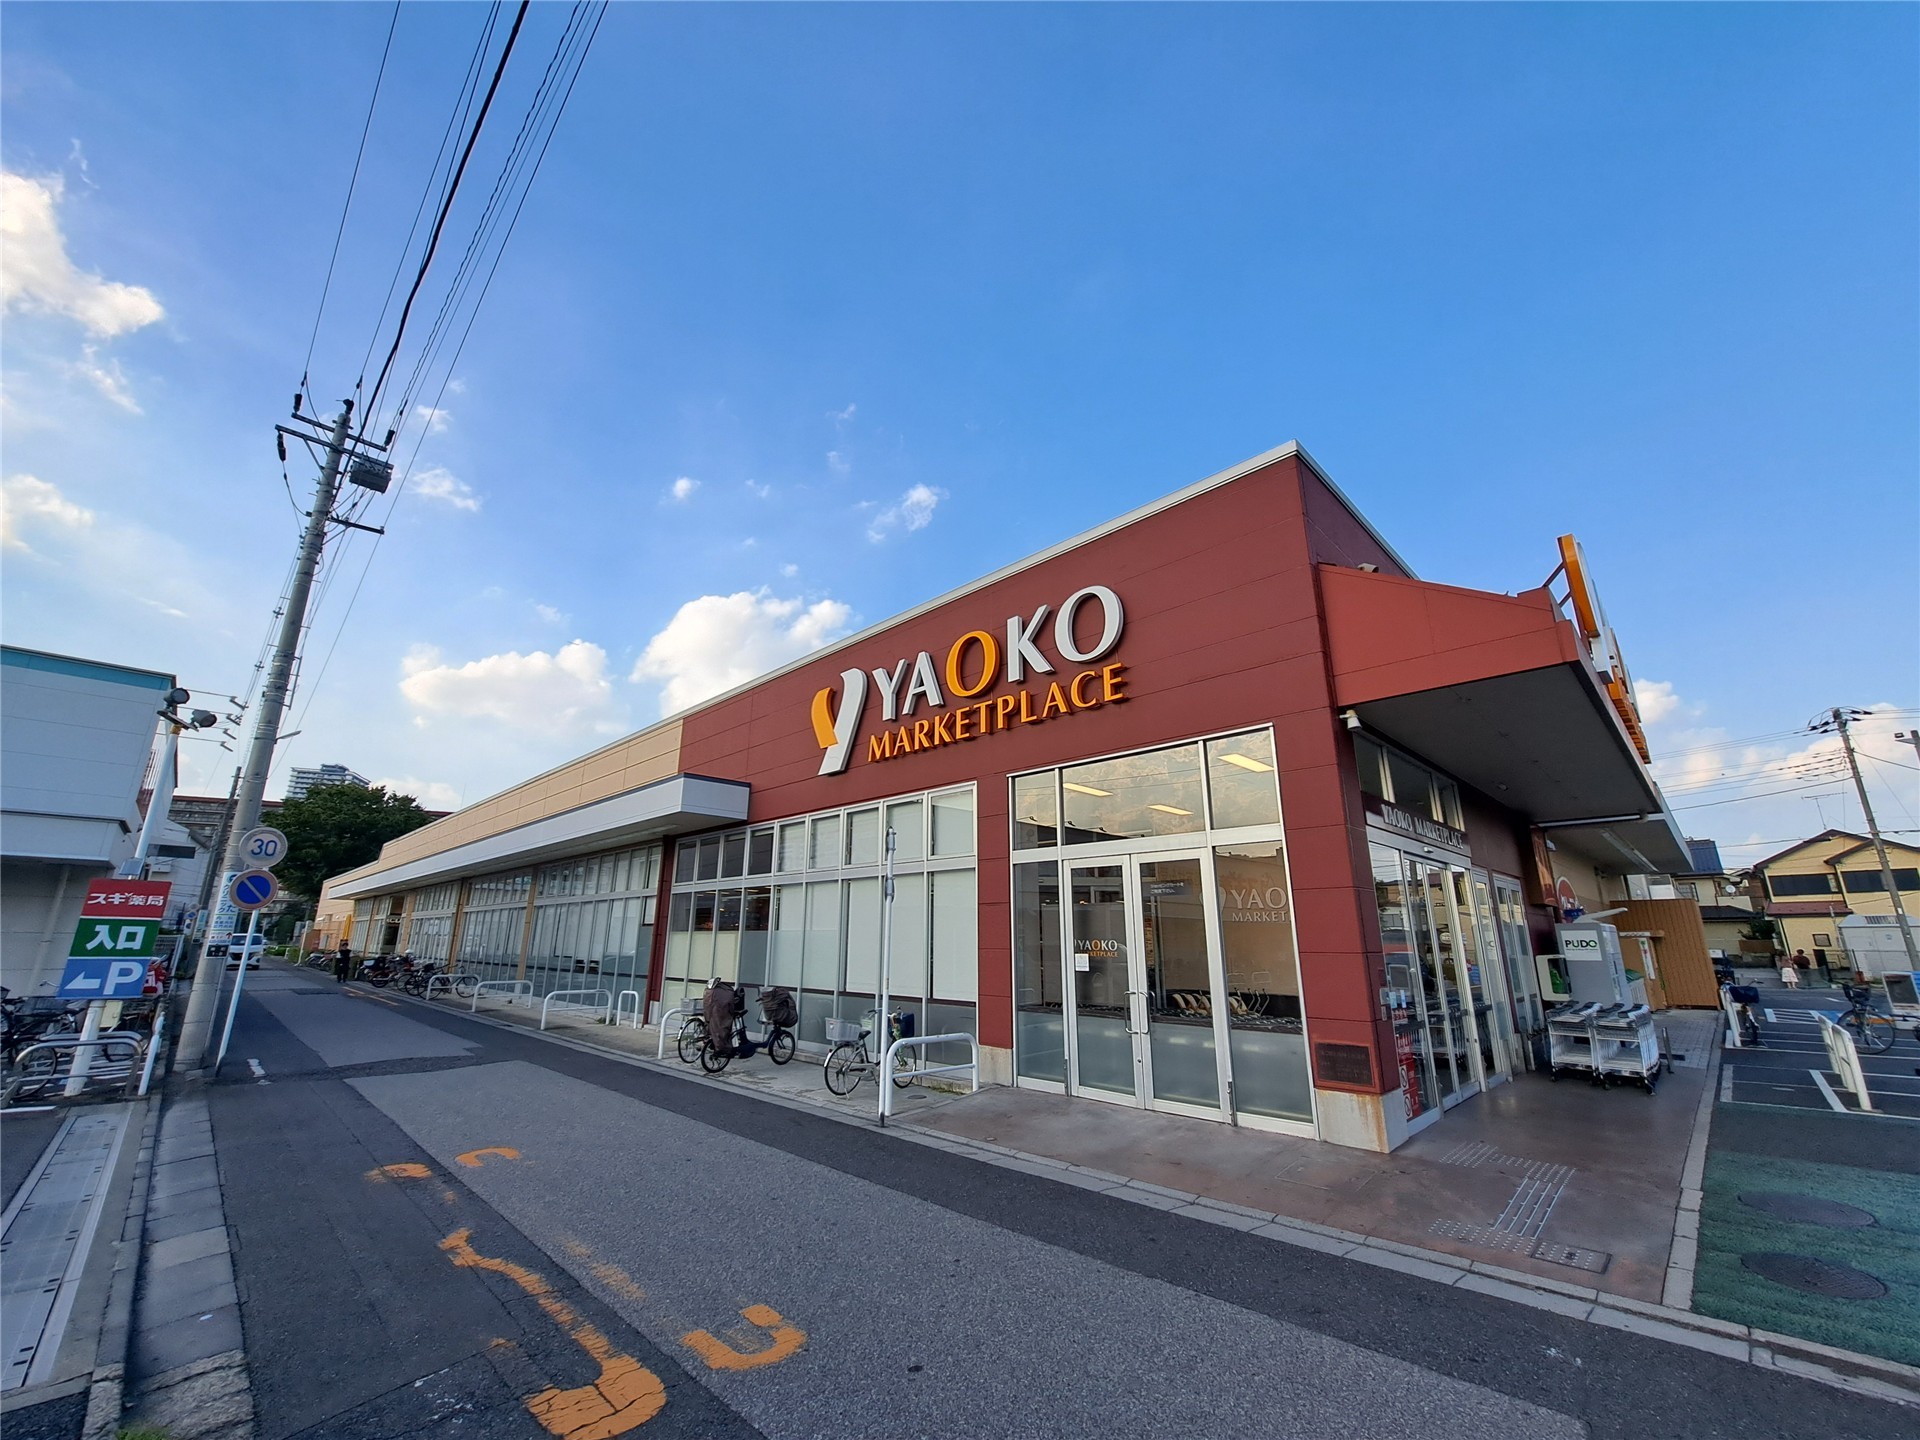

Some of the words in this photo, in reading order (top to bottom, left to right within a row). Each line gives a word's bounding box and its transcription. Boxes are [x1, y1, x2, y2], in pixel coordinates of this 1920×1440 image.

[872, 585, 1125, 721] YAOKO
[867, 662, 1126, 762] MARKETPLACE
[1381, 804, 1412, 831] YAOKO
[1414, 817, 1464, 848] MARKETPLACE
[251, 838, 278, 857] 30
[87, 893, 164, 906] スギ薬局
[86, 925, 146, 950] 入口
[1078, 939, 1118, 951] YAOKO
[1565, 940, 1598, 948] PUDO
[103, 962, 143, 995] P
